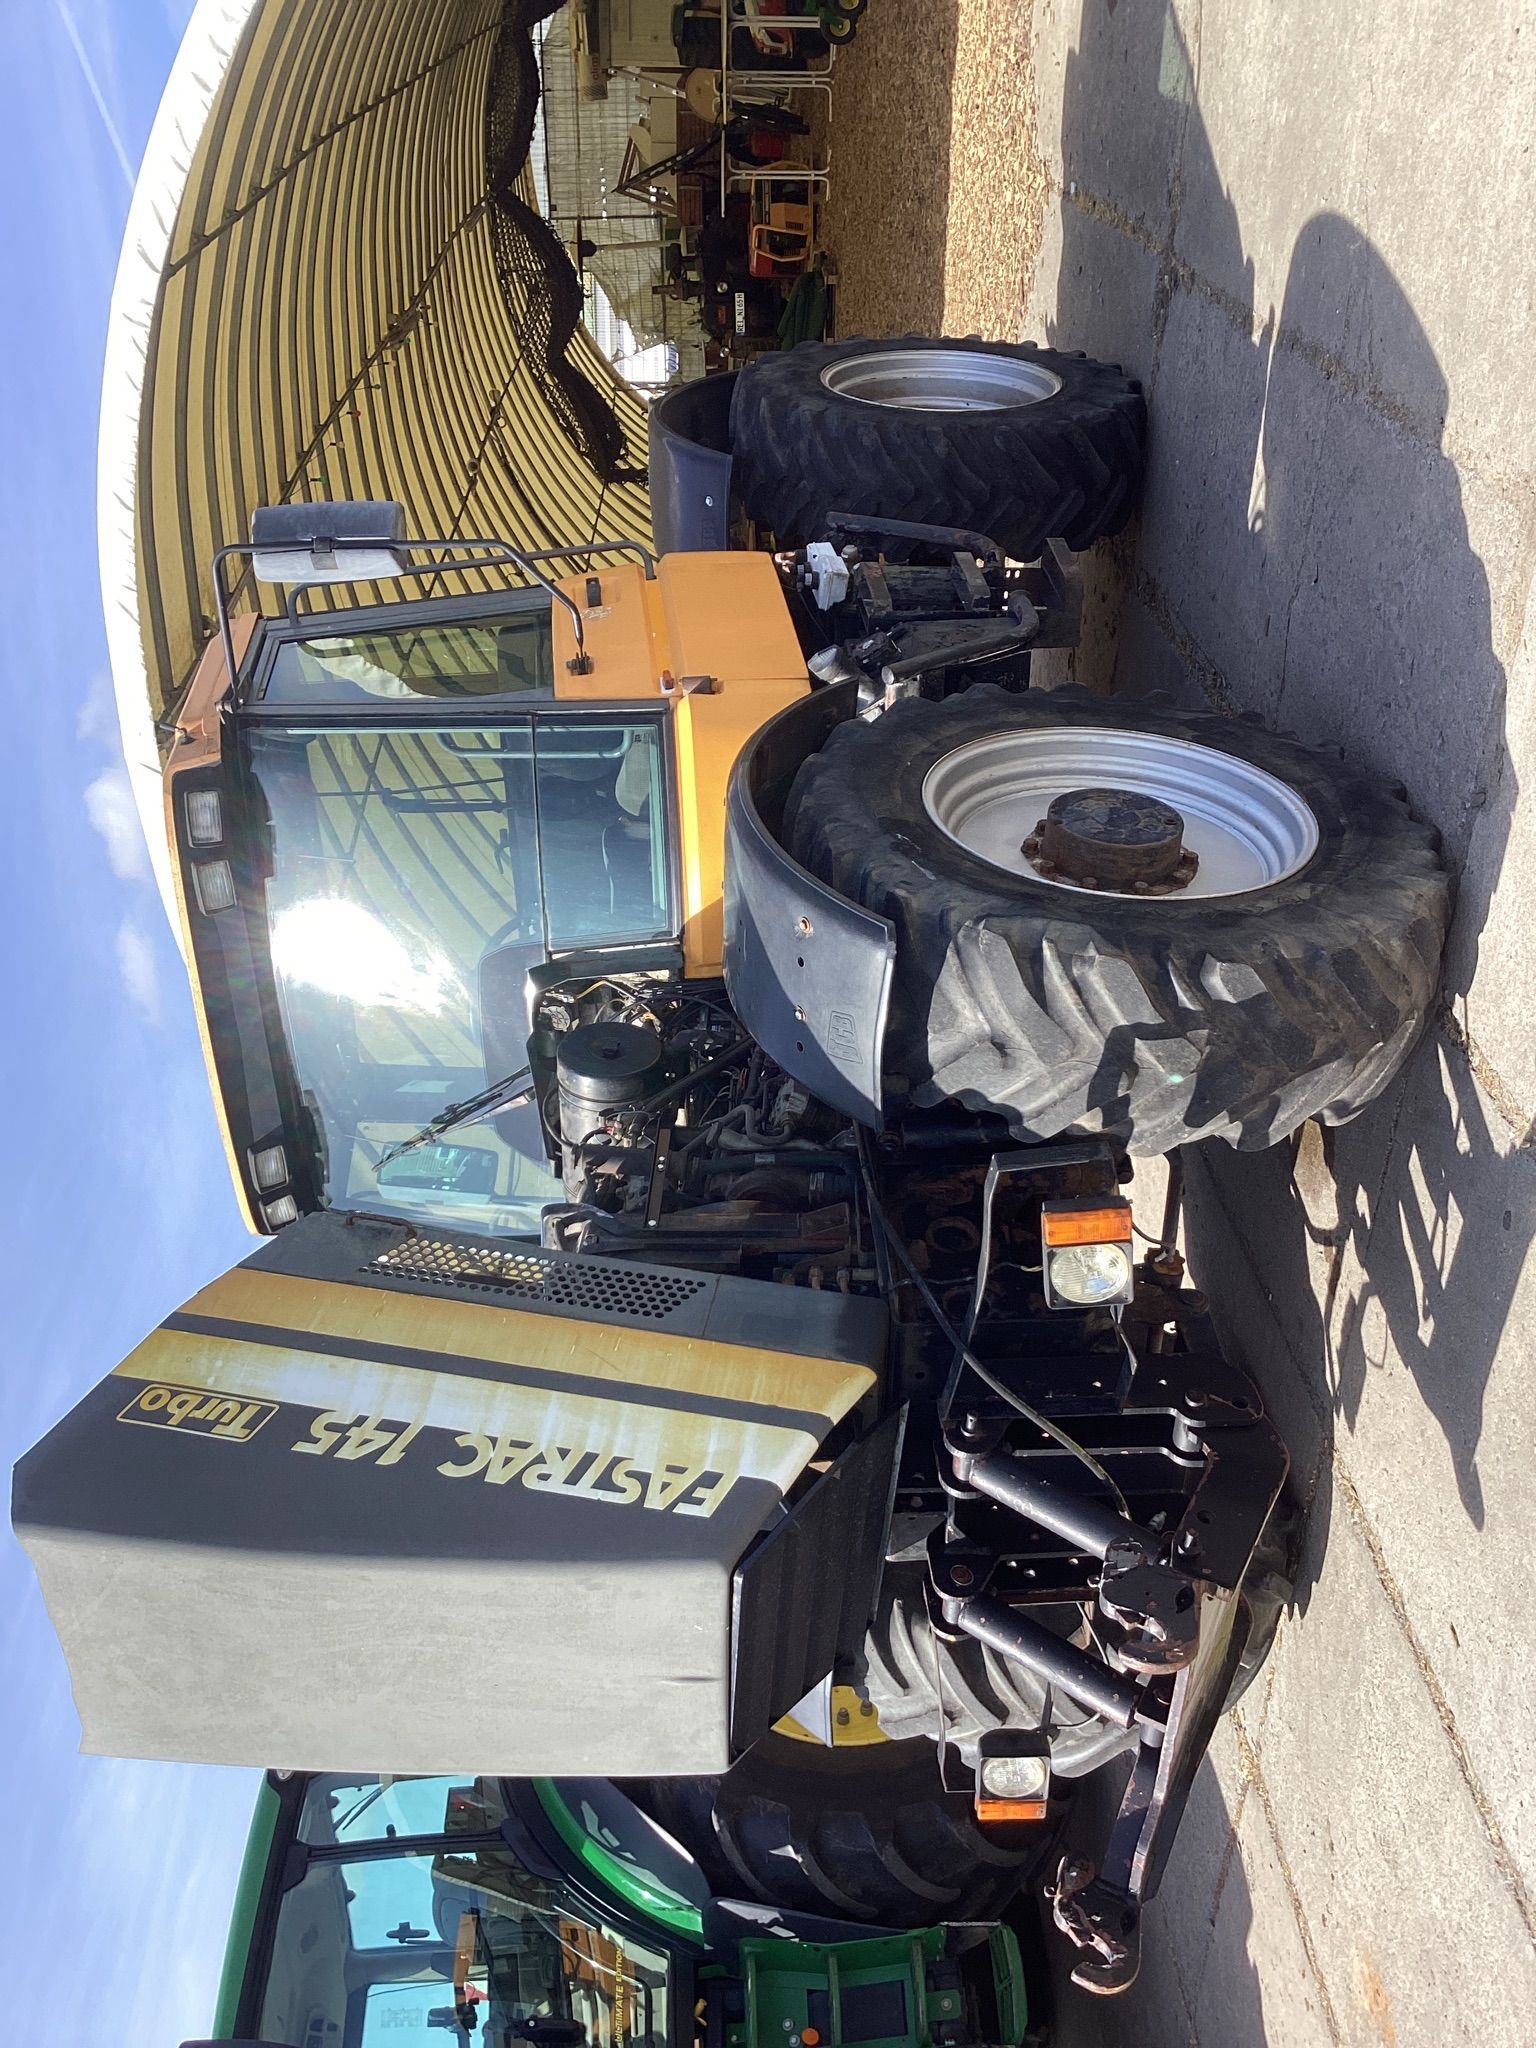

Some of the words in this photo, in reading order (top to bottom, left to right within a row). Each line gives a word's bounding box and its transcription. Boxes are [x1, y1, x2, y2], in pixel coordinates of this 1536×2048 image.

[829, 1014, 859, 1060] JCB
[137, 1388, 264, 1438] Turbo
[290, 1410, 426, 1465] 145
[436, 1430, 741, 1518] FASTRAC
[615, 1985, 624, 2042] ULTIMATE
